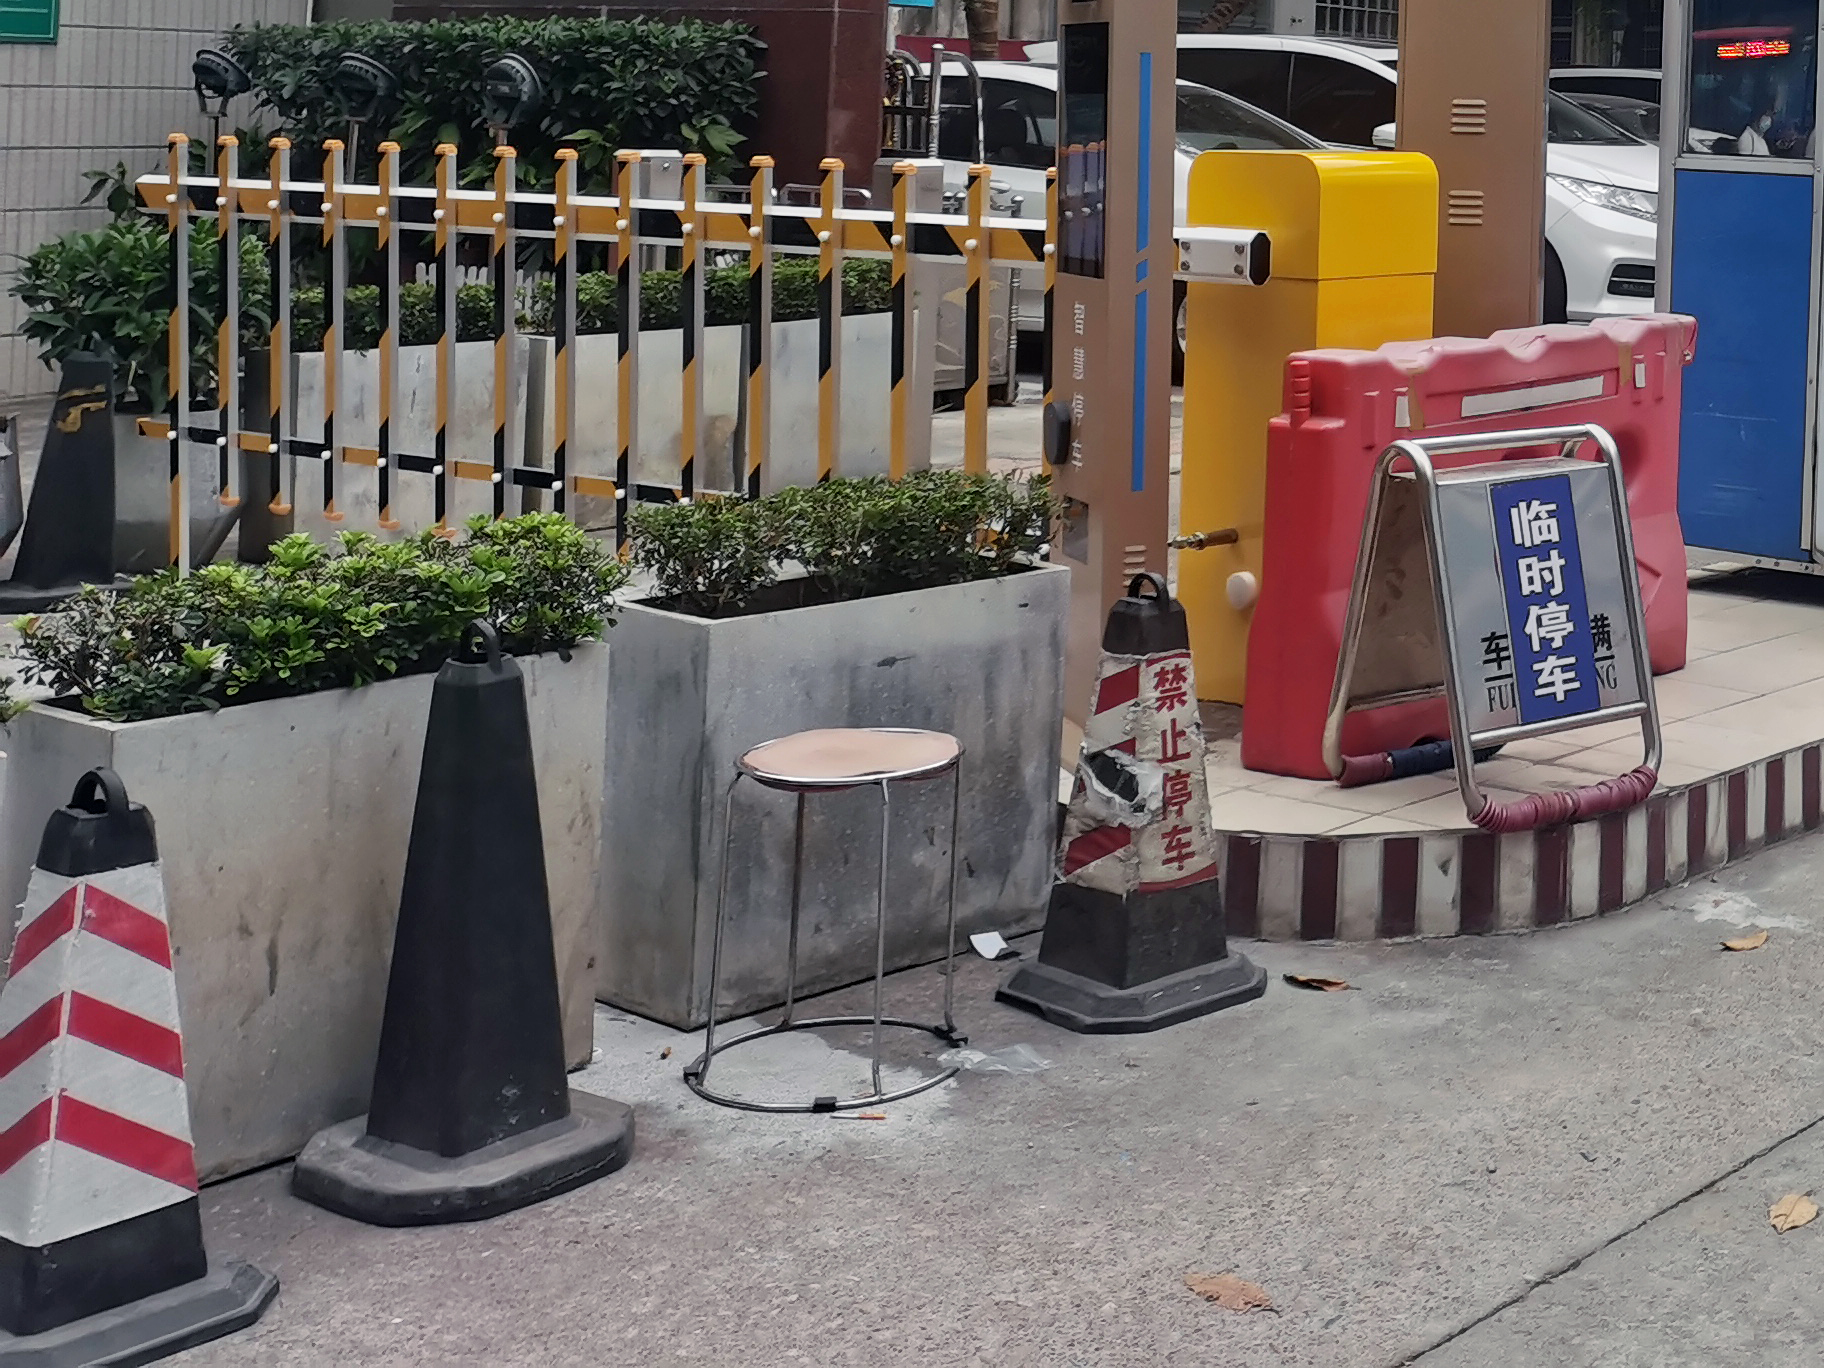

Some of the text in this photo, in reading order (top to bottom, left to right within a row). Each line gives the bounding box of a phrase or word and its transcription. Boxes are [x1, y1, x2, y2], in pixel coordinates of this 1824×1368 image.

[1509, 498, 1582, 702] 临时停车
[1152, 662, 1196, 871] 禁止停车
